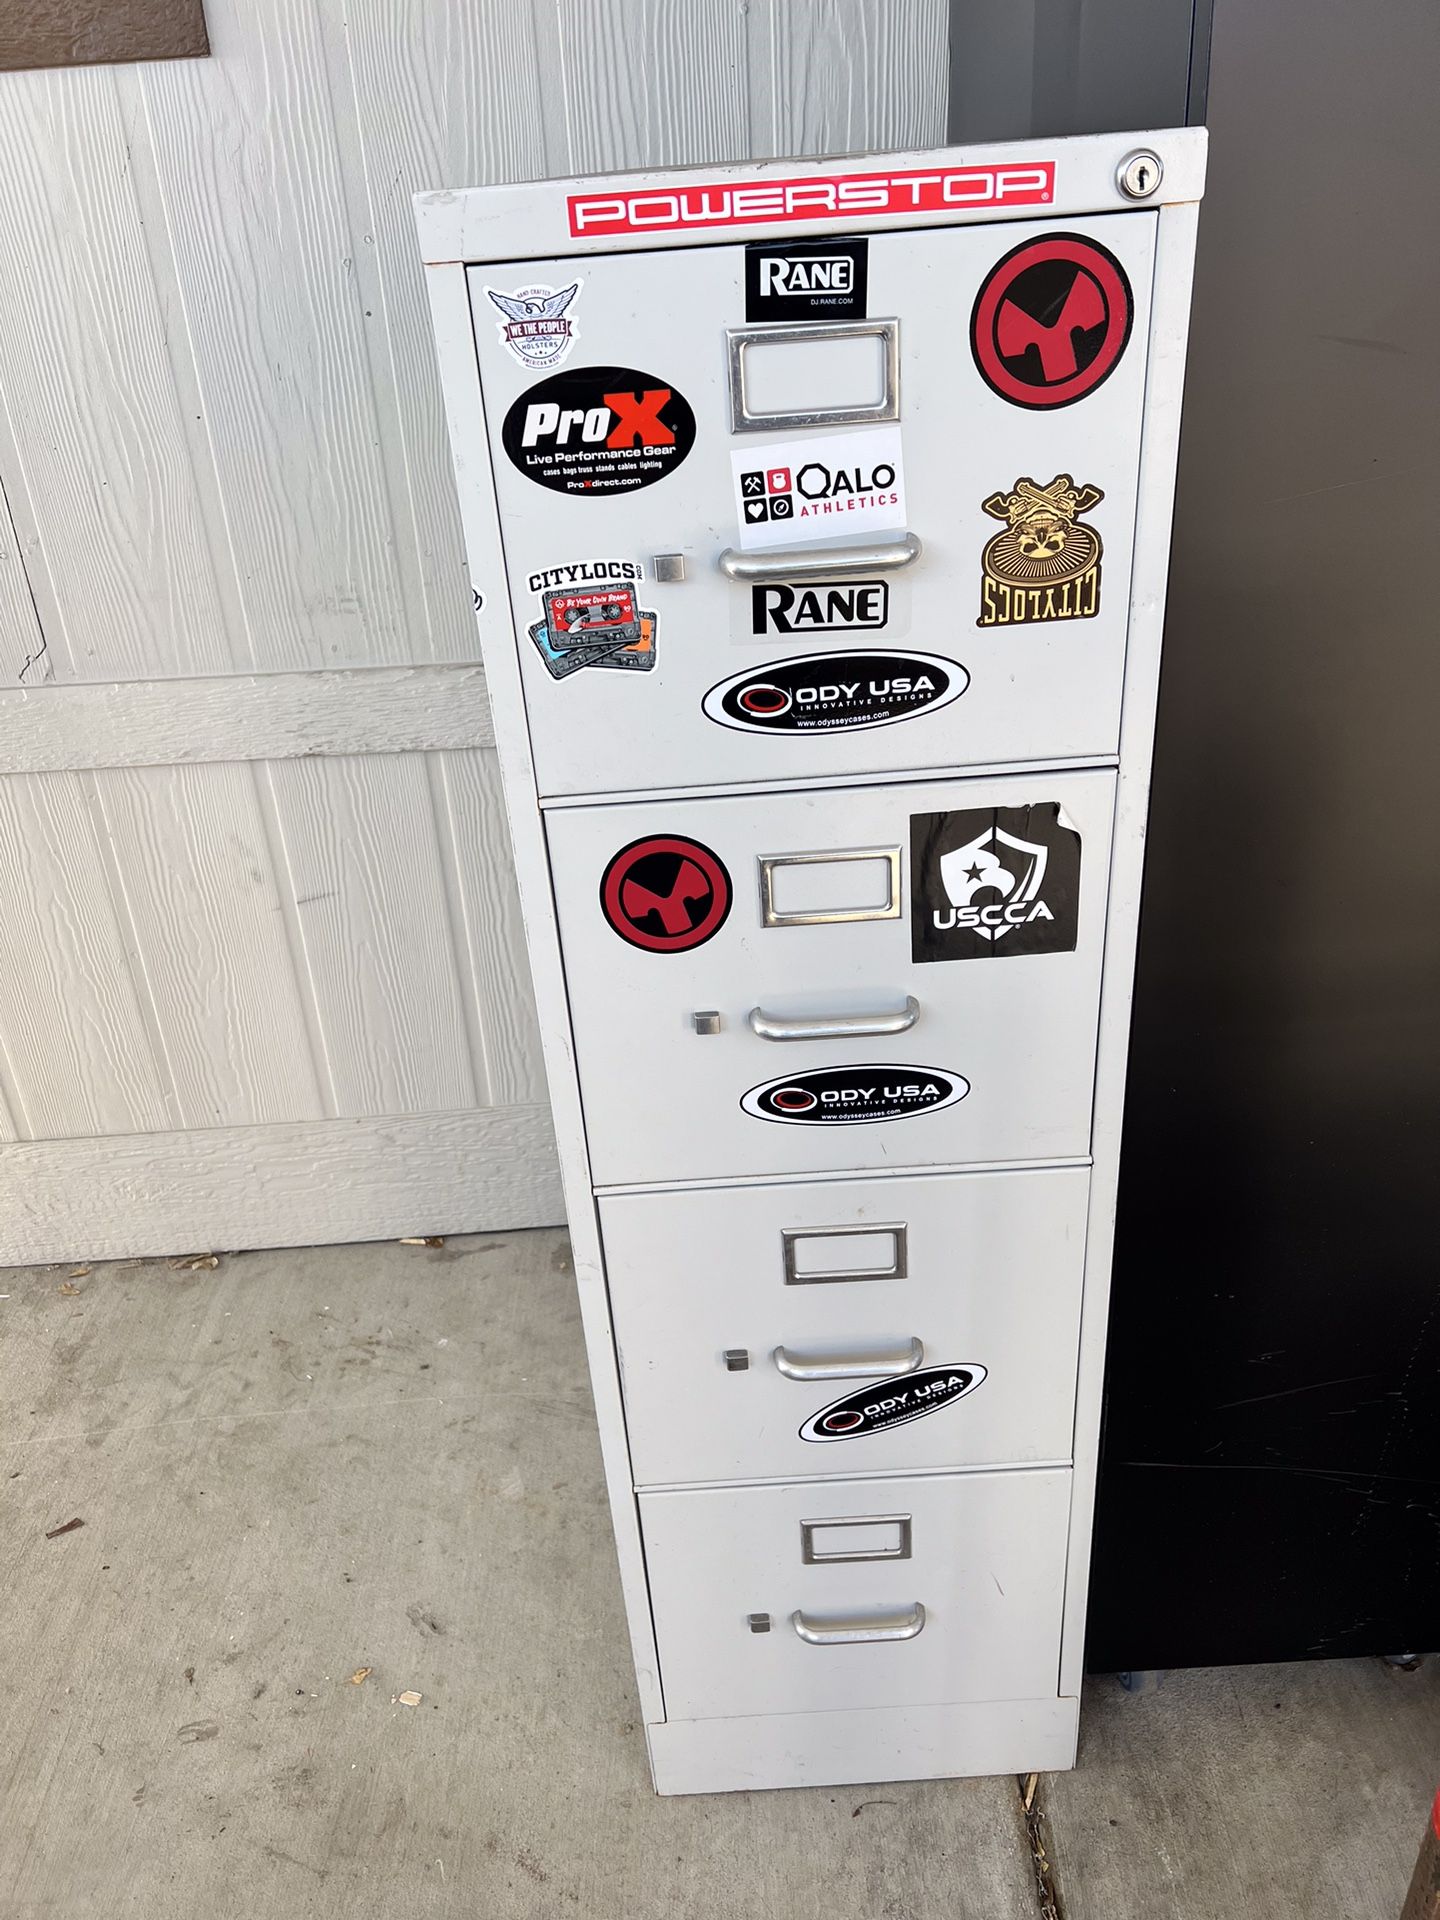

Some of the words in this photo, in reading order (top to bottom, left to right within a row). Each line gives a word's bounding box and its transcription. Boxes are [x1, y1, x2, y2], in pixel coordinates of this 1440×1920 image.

[575, 169, 1047, 229] POWERSTOP
[760, 256, 854, 296] RANE
[510, 325, 523, 336] WE
[523, 323, 537, 334] THE
[538, 321, 565, 334] PEOPLE
[522, 342, 558, 350] HOLSTERS
[521, 389, 676, 448] ProX
[526, 454, 552, 465] Live
[555, 449, 641, 463] Performance
[643, 446, 676, 456] Gear
[543, 468, 561, 476] cases
[563, 467, 577, 476] bags
[595, 464, 615, 472] stands
[618, 462, 637, 470] cables
[639, 461, 662, 470] lighting
[567, 478, 642, 489] ProXdirect.com
[796, 463, 895, 500] QALO
[800, 493, 898, 517] ATHLETICS
[529, 562, 635, 592] CITYLOCS
[752, 579, 889, 635] RANE
[984, 566, 1098, 624] CITYLOCS
[796, 682, 861, 703] ODY
[870, 675, 935, 696] USA
[800, 699, 872, 711] INNOVATIVE
[880, 693, 932, 703] DESIGNS
[797, 710, 890, 728] www.odysseycases.com
[933, 900, 1055, 930] USCCA
[820, 1088, 877, 1102] ODY
[884, 1084, 940, 1097] USA
[824, 1099, 886, 1108] INNOVATIVE
[893, 1096, 938, 1104] DESIGNS
[821, 1108, 901, 1120] www.odysseycases.com
[863, 1392, 909, 1416] ODY
[914, 1376, 964, 1397] USA
